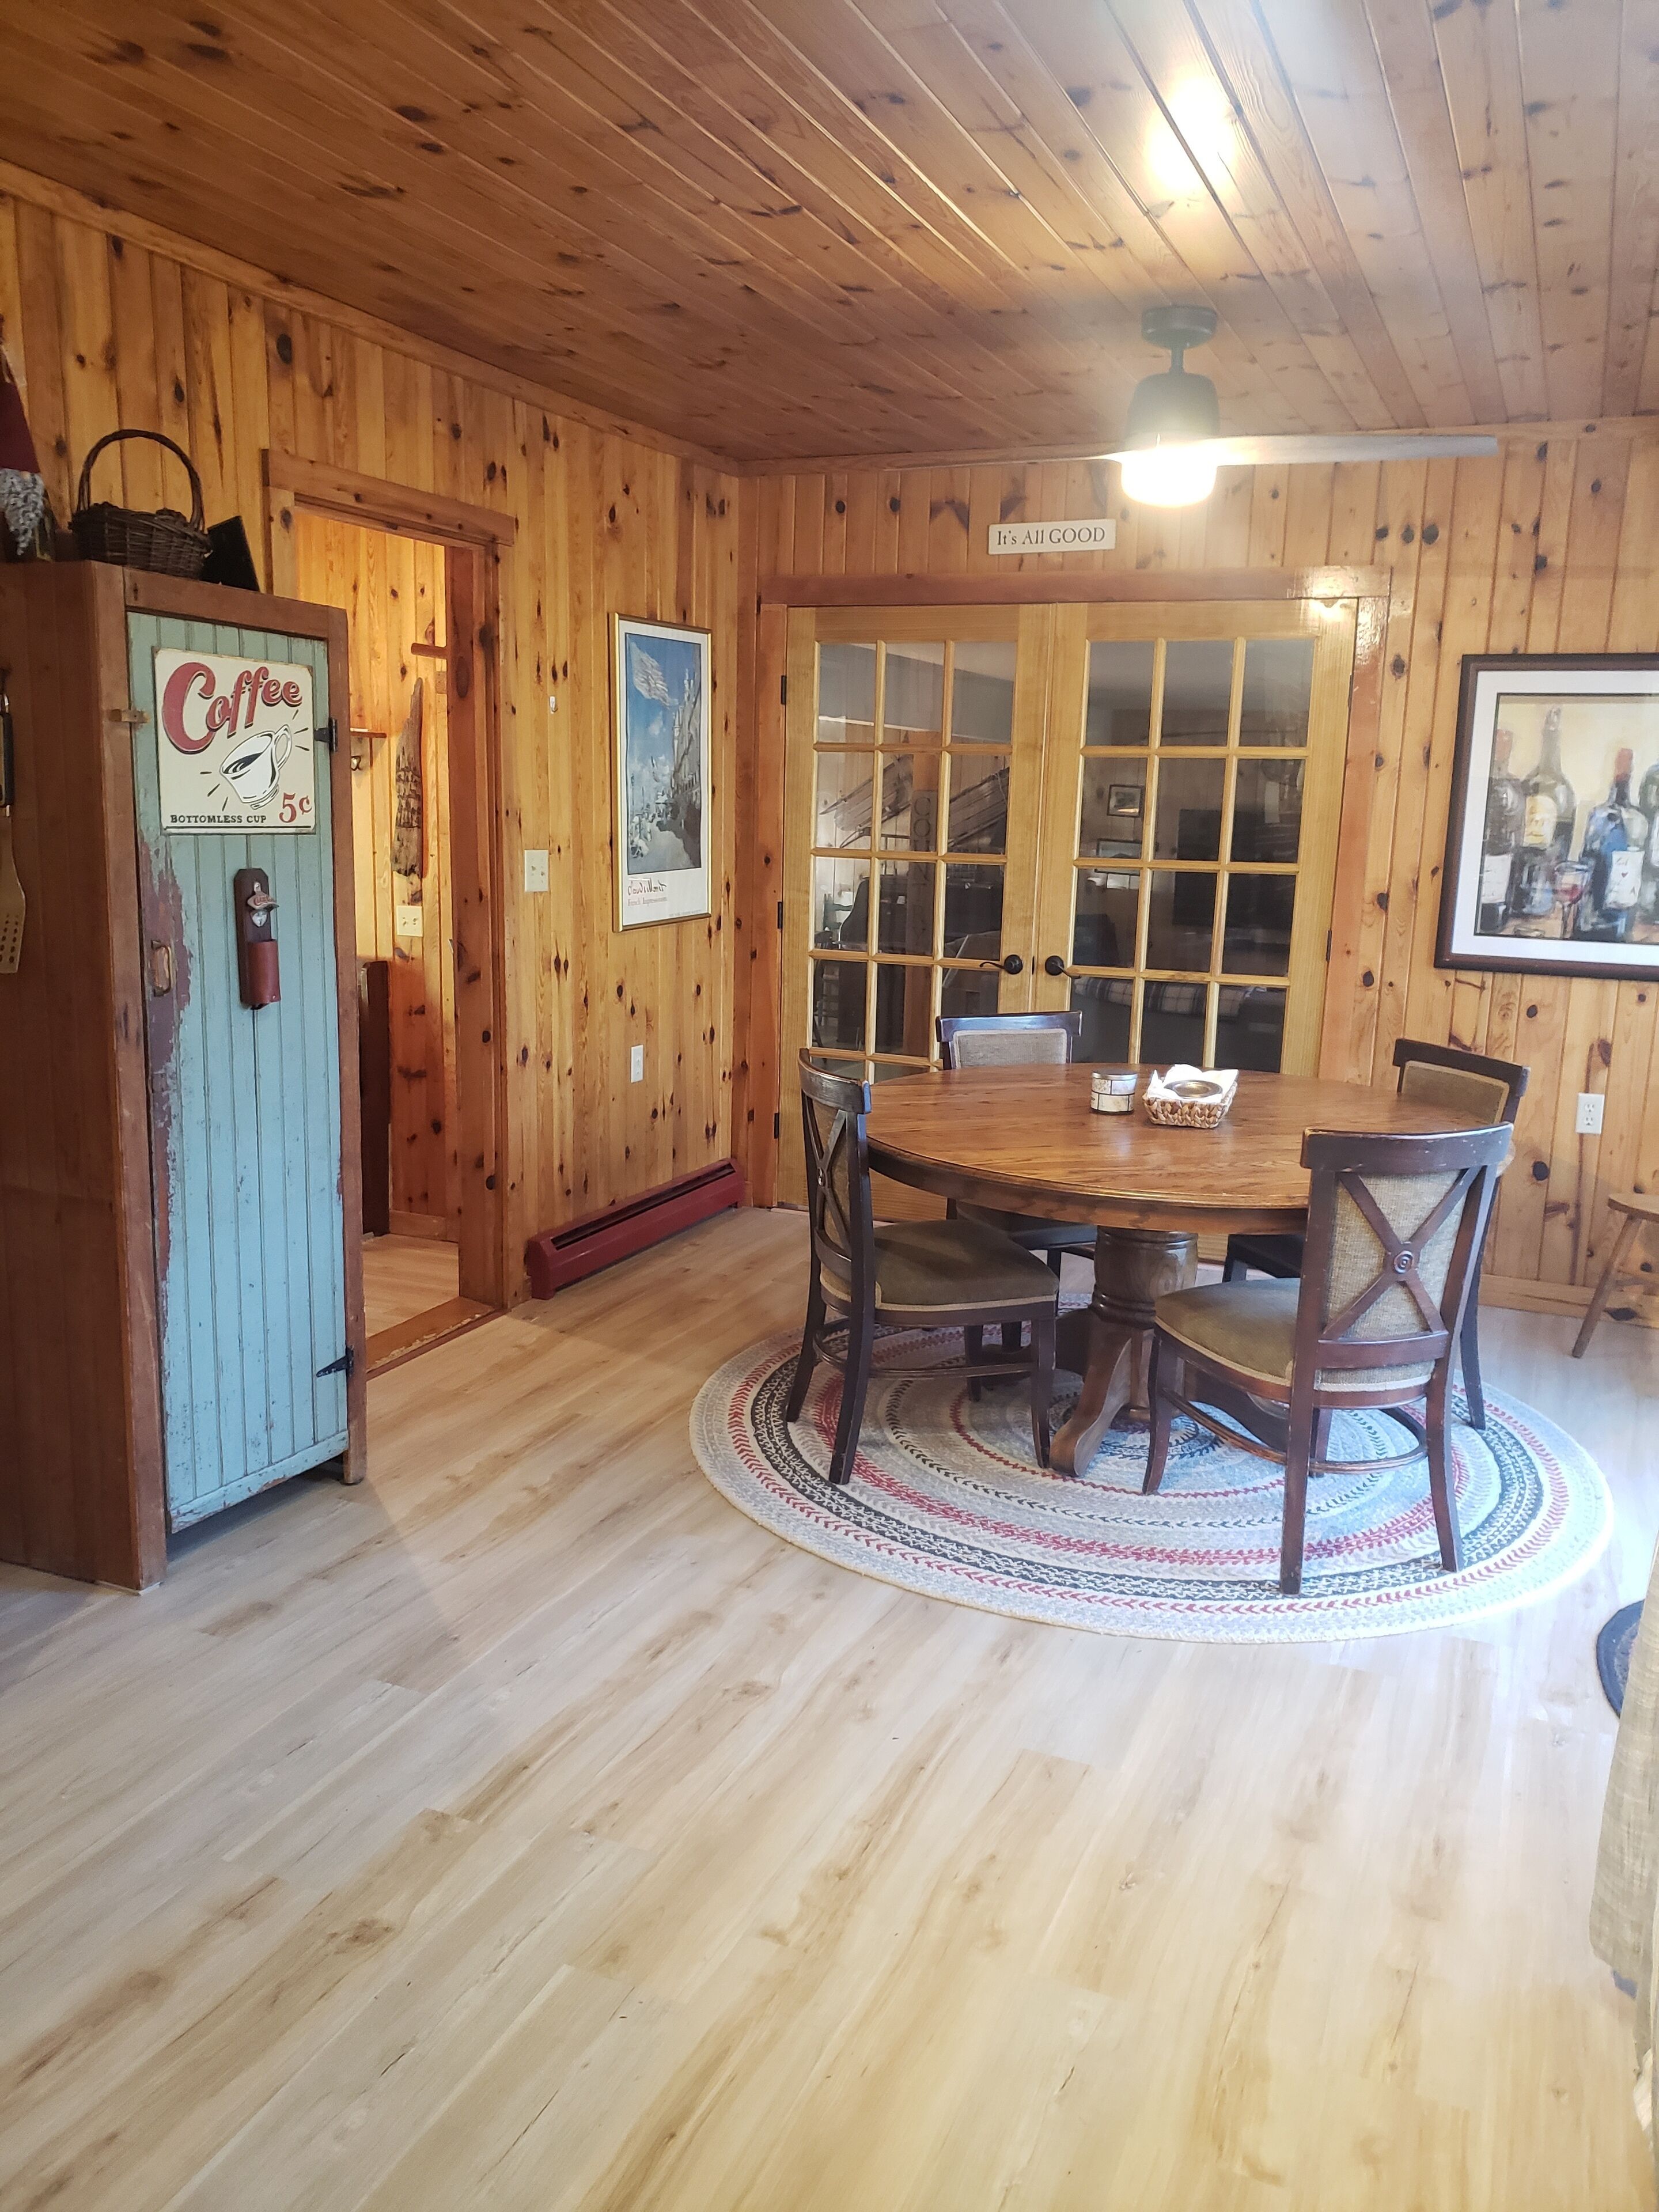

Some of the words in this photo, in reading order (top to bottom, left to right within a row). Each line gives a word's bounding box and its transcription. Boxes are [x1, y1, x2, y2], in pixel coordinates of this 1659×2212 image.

[997, 529, 1017, 546] It's
[1022, 529, 1044, 545] All
[1049, 527, 1105, 544] GOOD
[162, 662, 302, 755] Coffee
[170, 815, 243, 824] BOTTOMLESS
[247, 815, 267, 824] CUP
